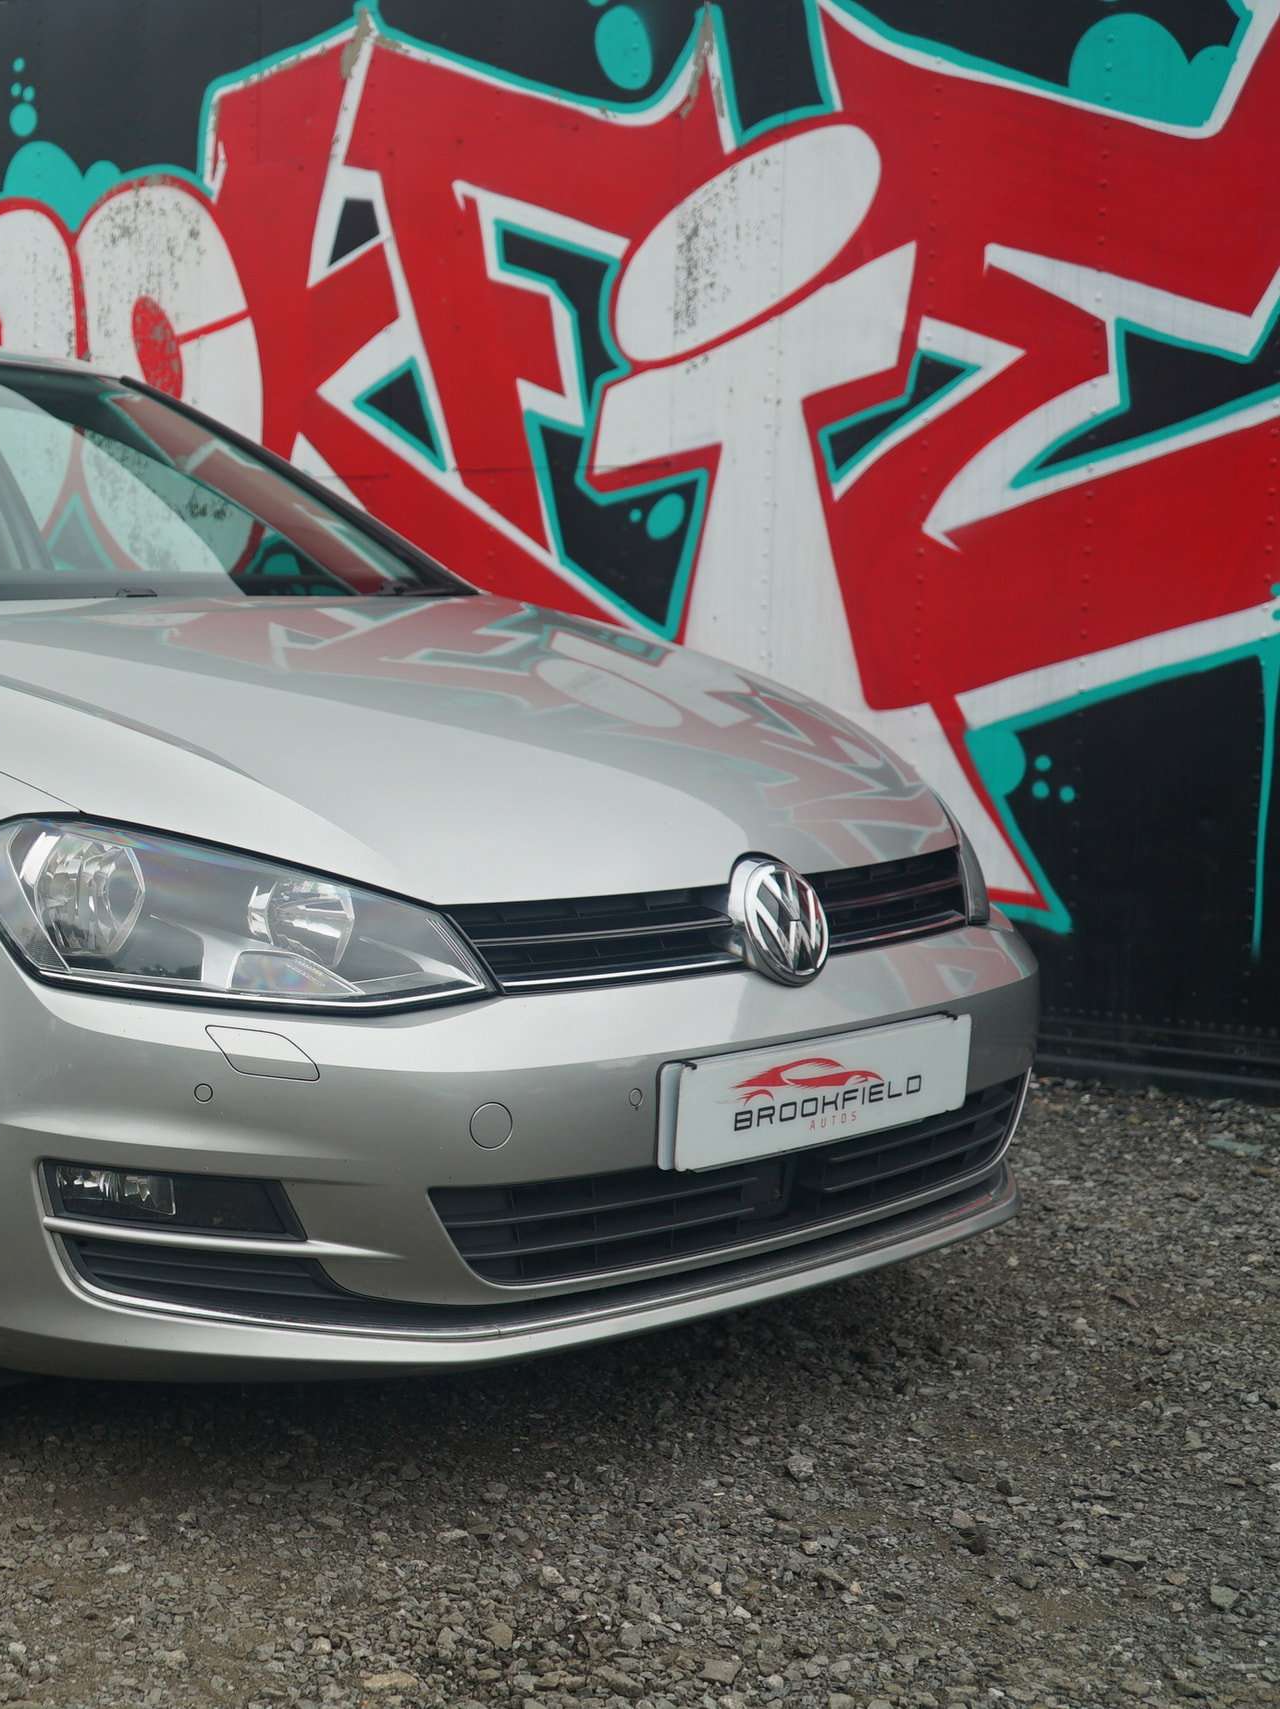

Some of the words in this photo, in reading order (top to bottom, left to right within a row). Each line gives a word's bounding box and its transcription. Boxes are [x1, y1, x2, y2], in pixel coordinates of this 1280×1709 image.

[743, 860, 829, 980] VW
[733, 1074, 922, 1132] BROOKFIELD
[808, 1110, 858, 1131] AUTOS
